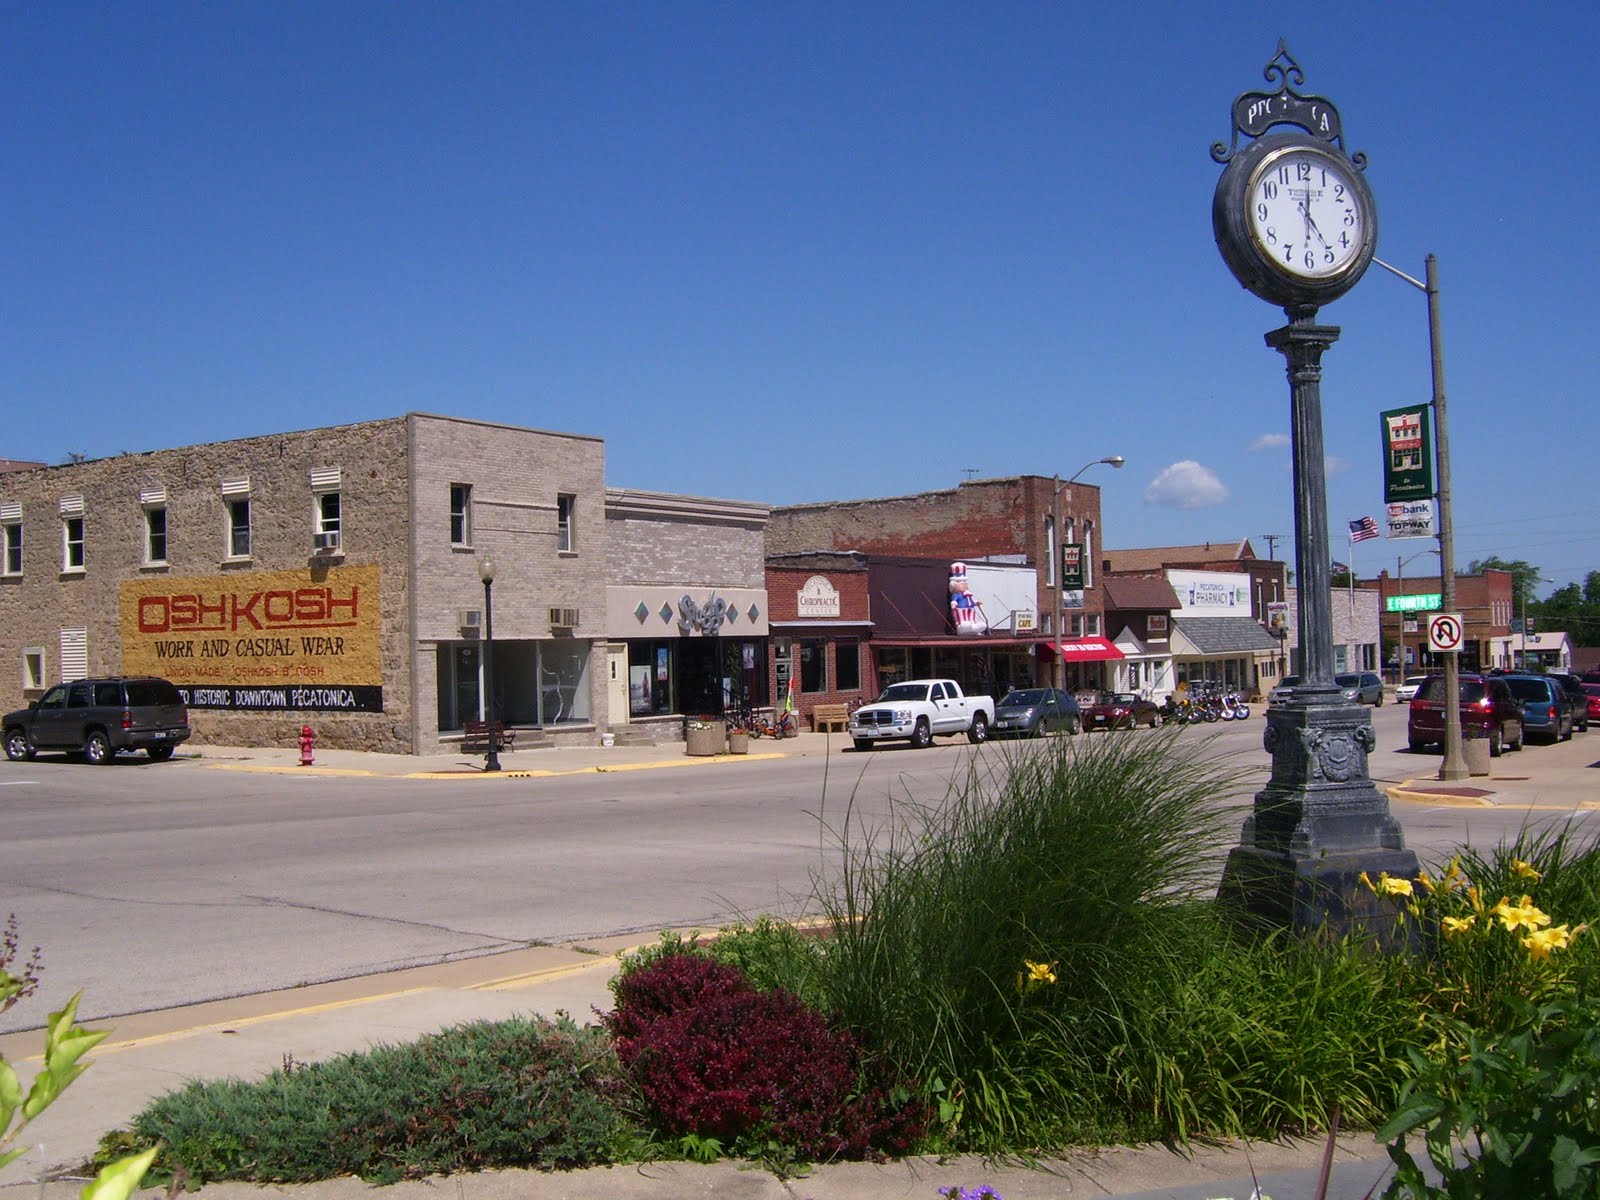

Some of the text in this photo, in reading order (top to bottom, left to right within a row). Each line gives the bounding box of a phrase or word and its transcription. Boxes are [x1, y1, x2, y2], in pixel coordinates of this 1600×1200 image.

[1279, 167, 1289, 185] 11
[1297, 163, 1311, 181] 12
[1321, 169, 1326, 187] 1
[1263, 181, 1278, 200] 10
[1334, 184, 1344, 203] 2
[1258, 203, 1268, 222] 9
[1343, 208, 1354, 226] 3
[1266, 226, 1277, 246] 8
[1338, 231, 1349, 249] 4
[1283, 244, 1293, 262] 7
[1304, 250, 1315, 269] 6
[1324, 246, 1335, 264] 5
[1388, 521, 1431, 531] TOPWAY
[1196, 592, 1229, 604] PHARMACY
[1388, 598, 1395, 610] E
[1396, 596, 1427, 610] FOURTH
[138, 586, 358, 634] OSHKOSH
[1018, 619, 1032, 628] CAFE
[154, 636, 346, 659] WORK AND CASUAL WEAR
[165, 667, 192, 677] UNION
[196, 667, 220, 677] MADE
[234, 666, 278, 677] OSHKOSH
[194, 689, 231, 706] HISTORIC
[235, 689, 287, 706] DOWNTOWN
